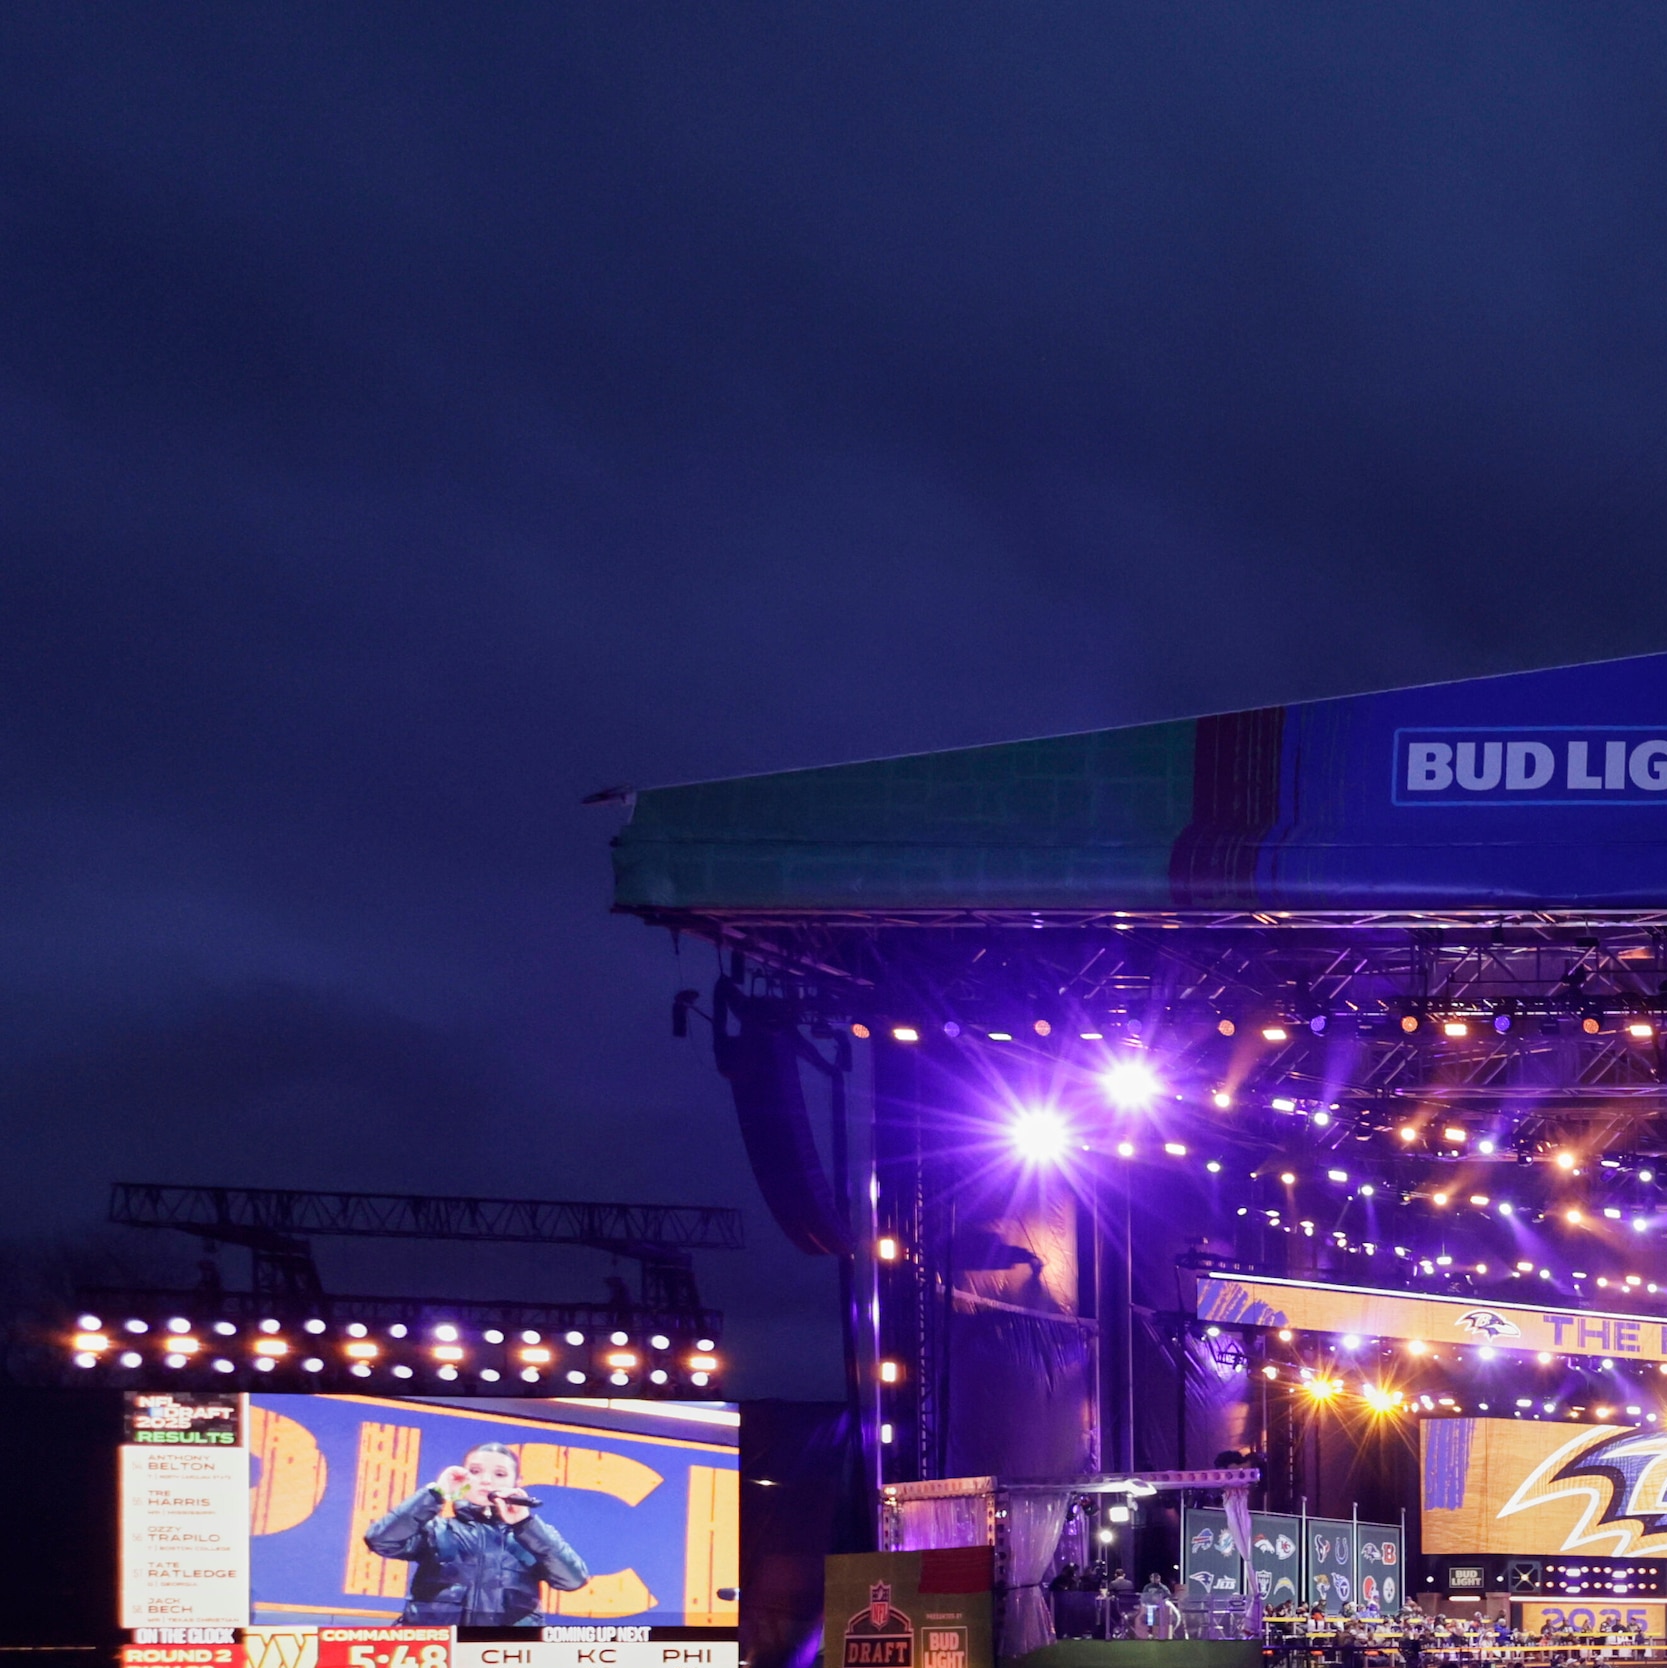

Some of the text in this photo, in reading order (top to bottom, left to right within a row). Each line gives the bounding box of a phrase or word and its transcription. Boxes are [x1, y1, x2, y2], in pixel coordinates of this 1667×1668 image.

[1407, 742, 1555, 791] BUD
[1544, 1314, 1640, 1353] THE
[138, 1397, 180, 1408] NFL
[164, 1407, 234, 1420] DRAFT
[136, 1417, 191, 1429] 2025
[136, 1431, 234, 1444] RESULTS
[148, 1462, 215, 1470] BELTON
[148, 1498, 211, 1507] HARRIS
[148, 1534, 220, 1542] TRAPILO
[148, 1570, 237, 1578] RATLEDGE
[1455, 1570, 1478, 1579] BUD
[1213, 1577, 1236, 1590] JETS
[1451, 1578, 1482, 1587] LIGHT
[148, 1606, 193, 1614] BECH
[136, 1629, 235, 1644] ON THE CLOCK
[321, 1629, 450, 1642] COMMANDERS
[542, 1627, 652, 1643] COMING UP NEXT
[929, 1632, 960, 1651] BUD
[127, 1650, 232, 1663] ROUND 2
[481, 1649, 532, 1664] CHI
[577, 1649, 618, 1664] KC
[663, 1649, 712, 1663] PHI
[847, 1641, 908, 1664] DRAFT
